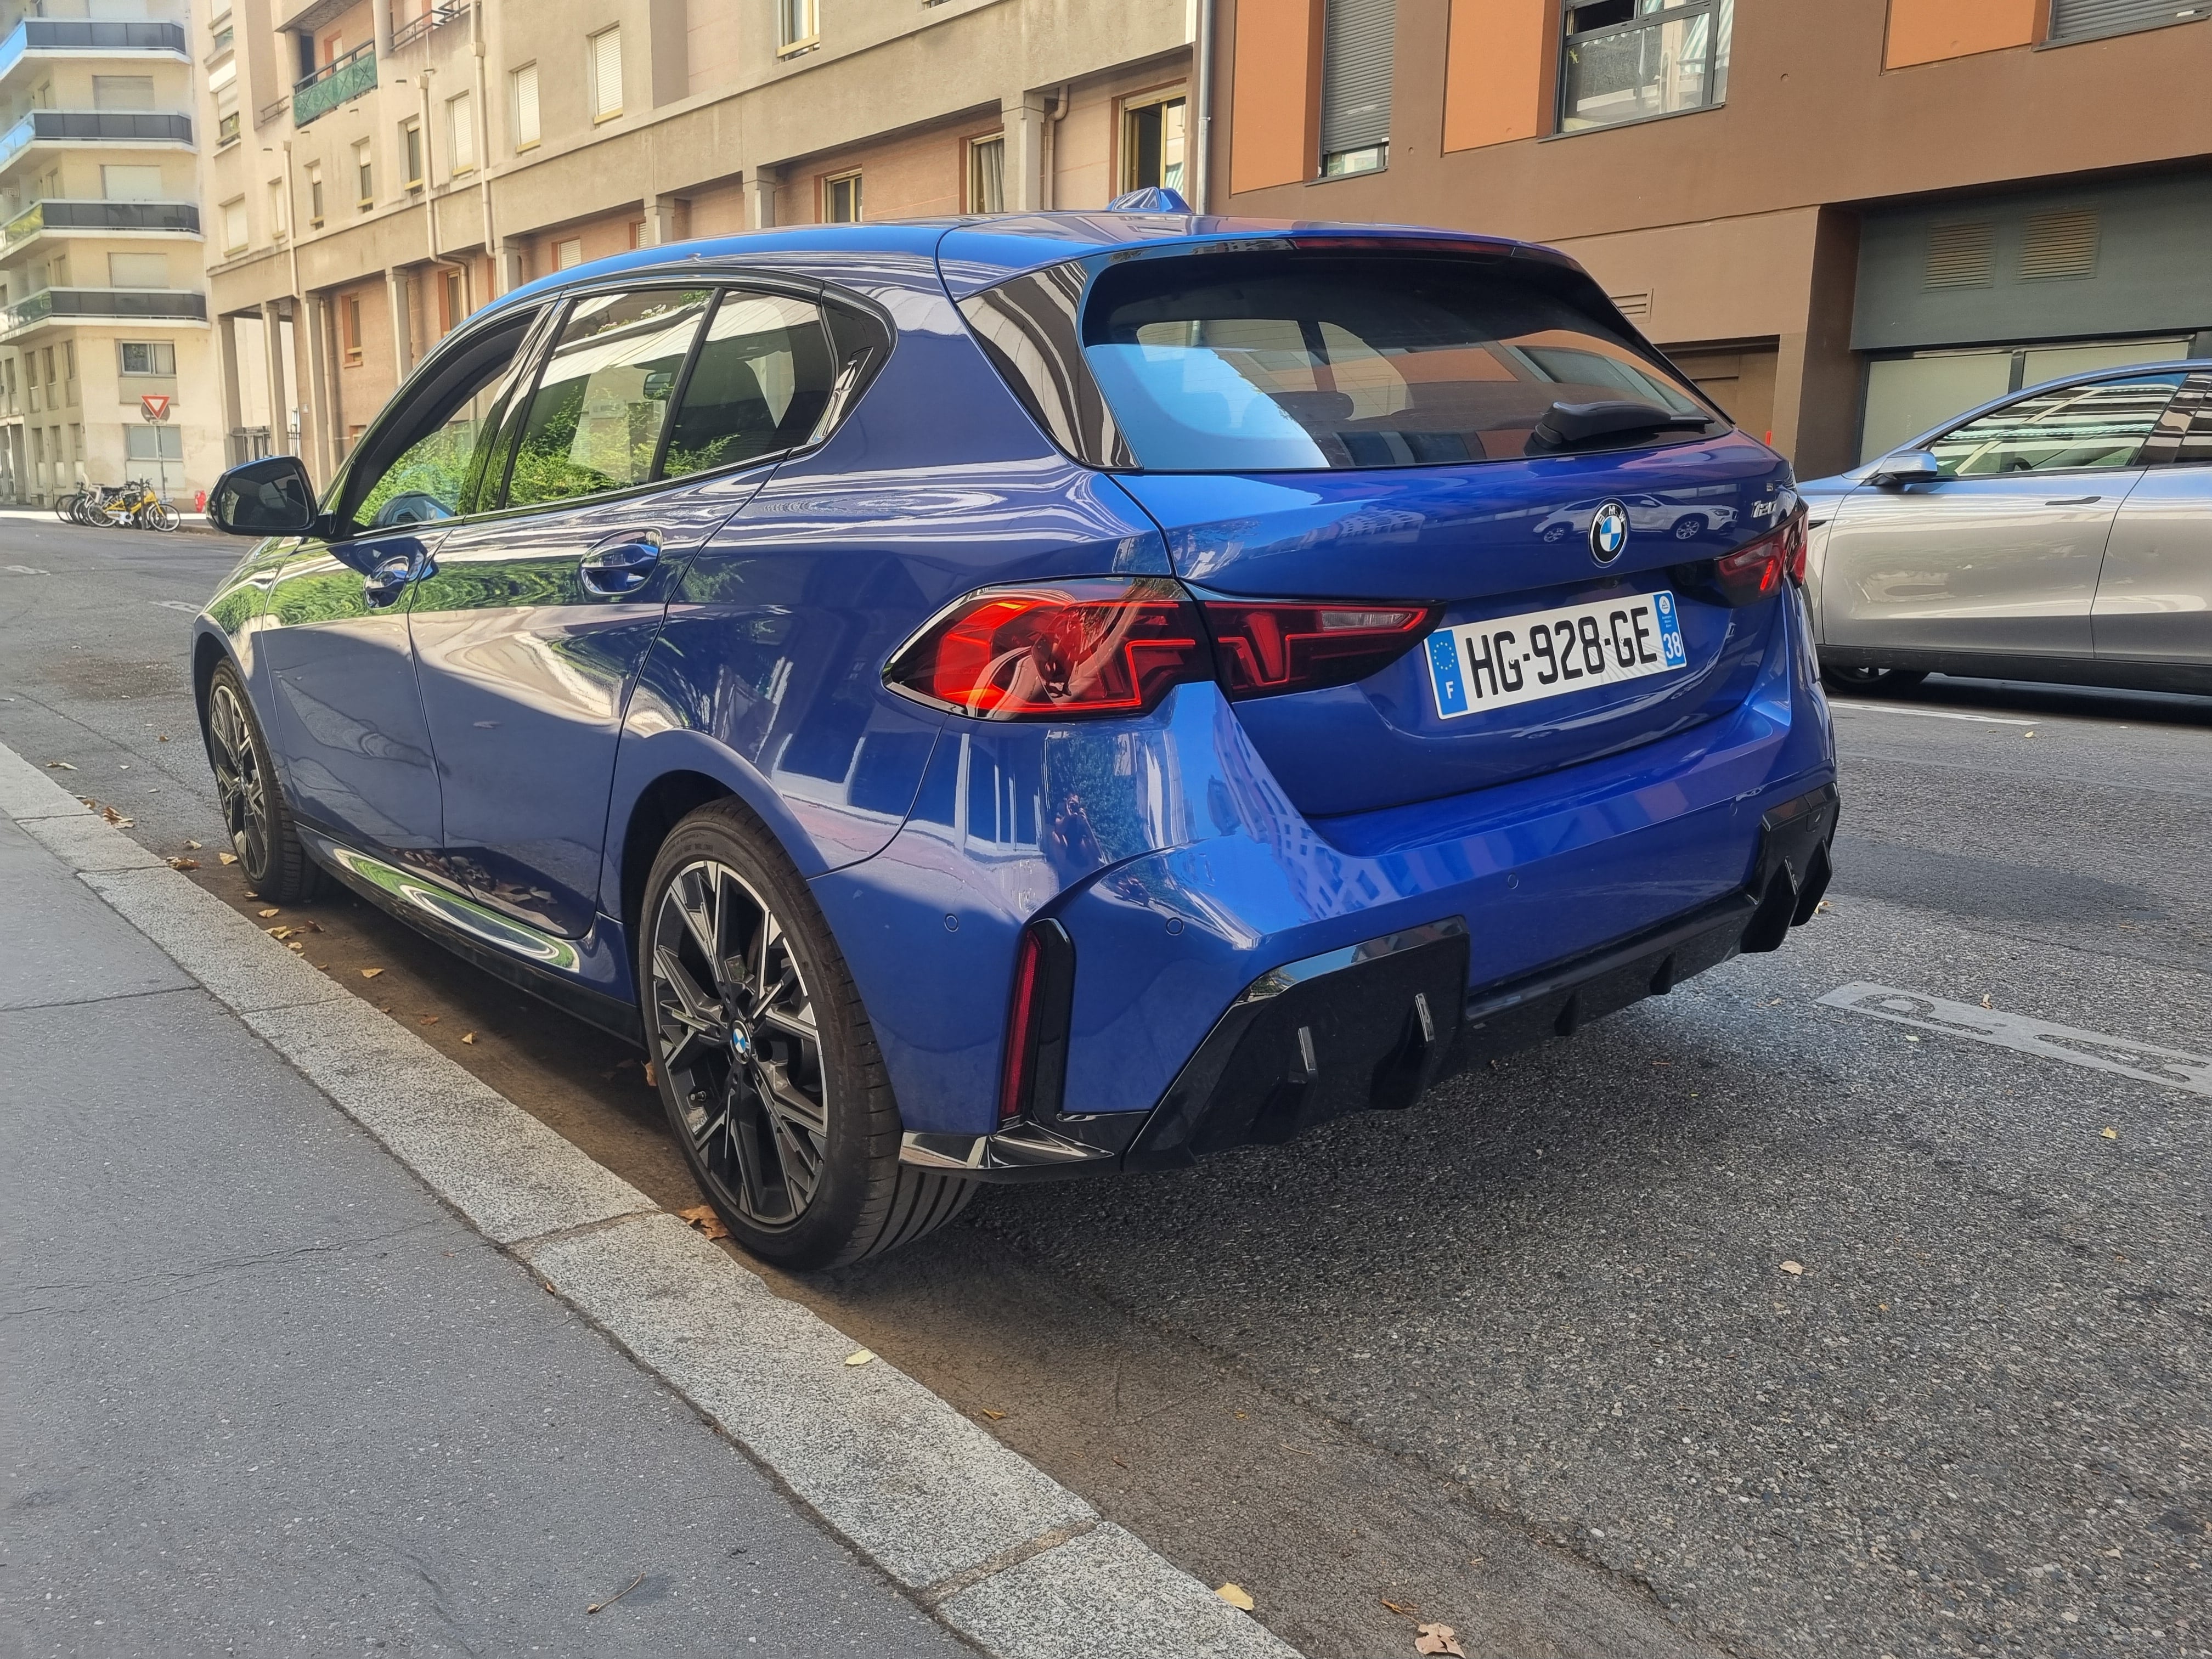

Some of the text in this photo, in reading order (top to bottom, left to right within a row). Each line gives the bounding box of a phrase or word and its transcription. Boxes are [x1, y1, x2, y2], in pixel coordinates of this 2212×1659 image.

[1596, 505, 1626, 525] BMW
[1465, 606, 1657, 698] HG-928-GE
[1663, 631, 1682, 659] 38
[1445, 680, 1454, 699] F
